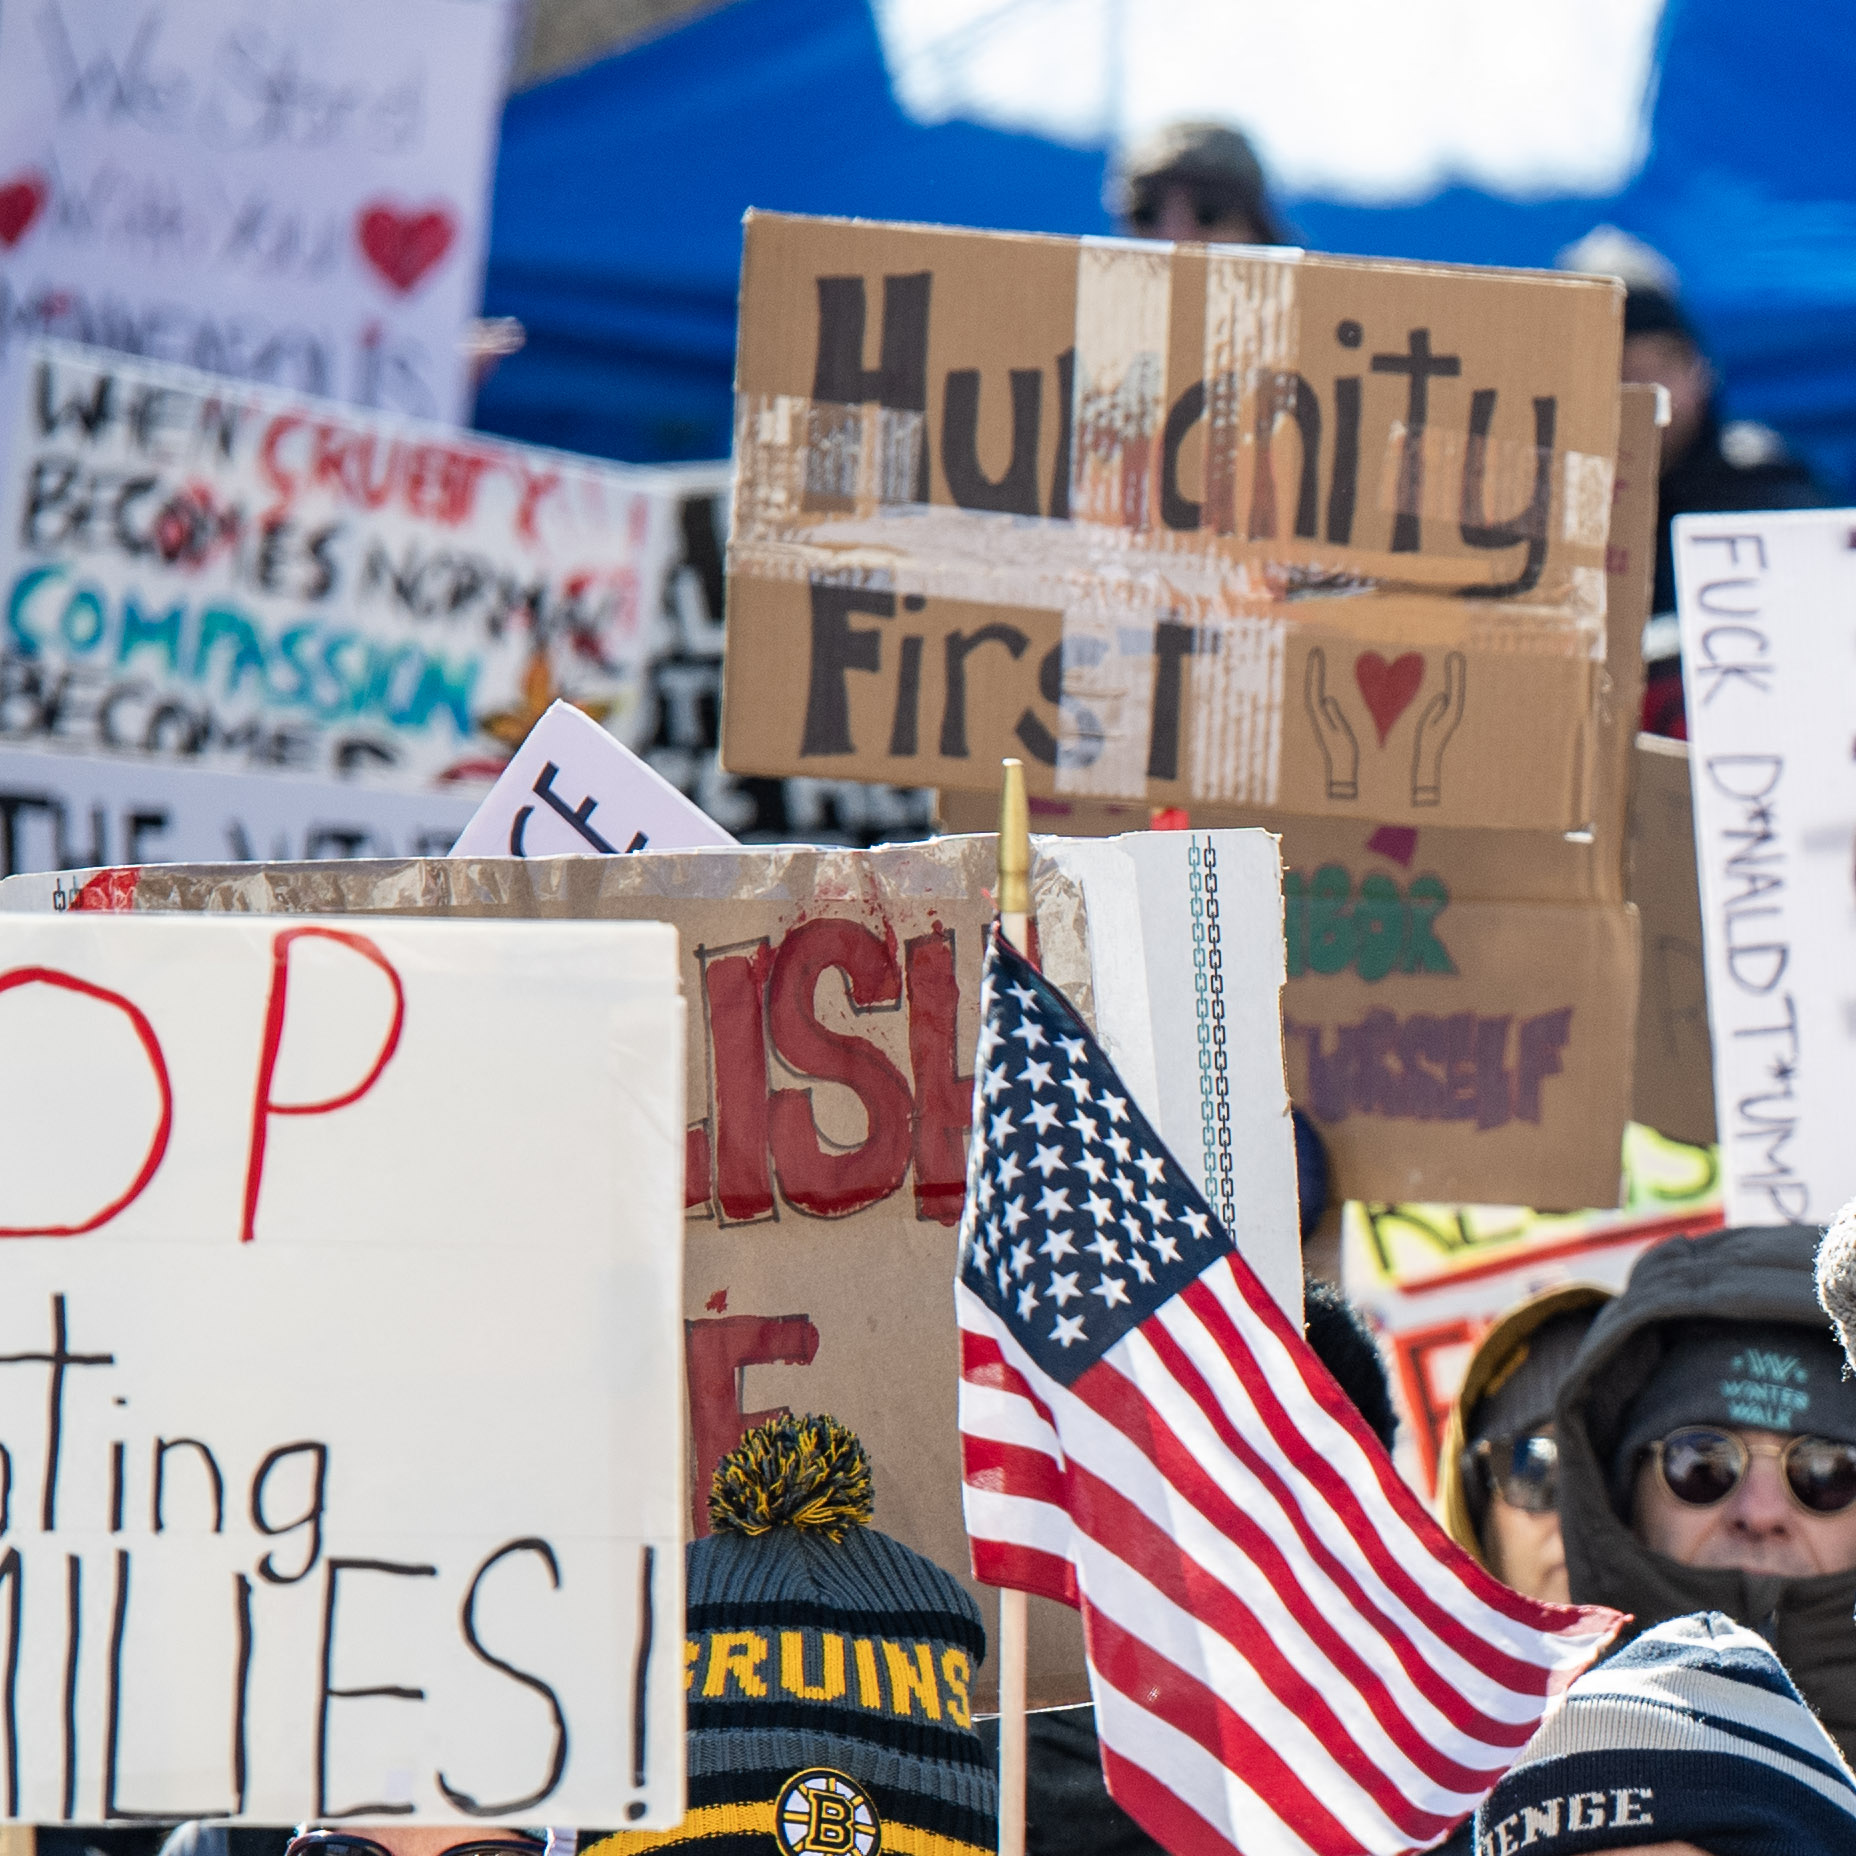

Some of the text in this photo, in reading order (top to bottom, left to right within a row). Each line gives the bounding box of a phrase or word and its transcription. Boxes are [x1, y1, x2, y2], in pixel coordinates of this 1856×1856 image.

[1690, 532, 1777, 706] FUCK
[0, 1293, 330, 1584] ting
[808, 1787, 857, 1856] B
